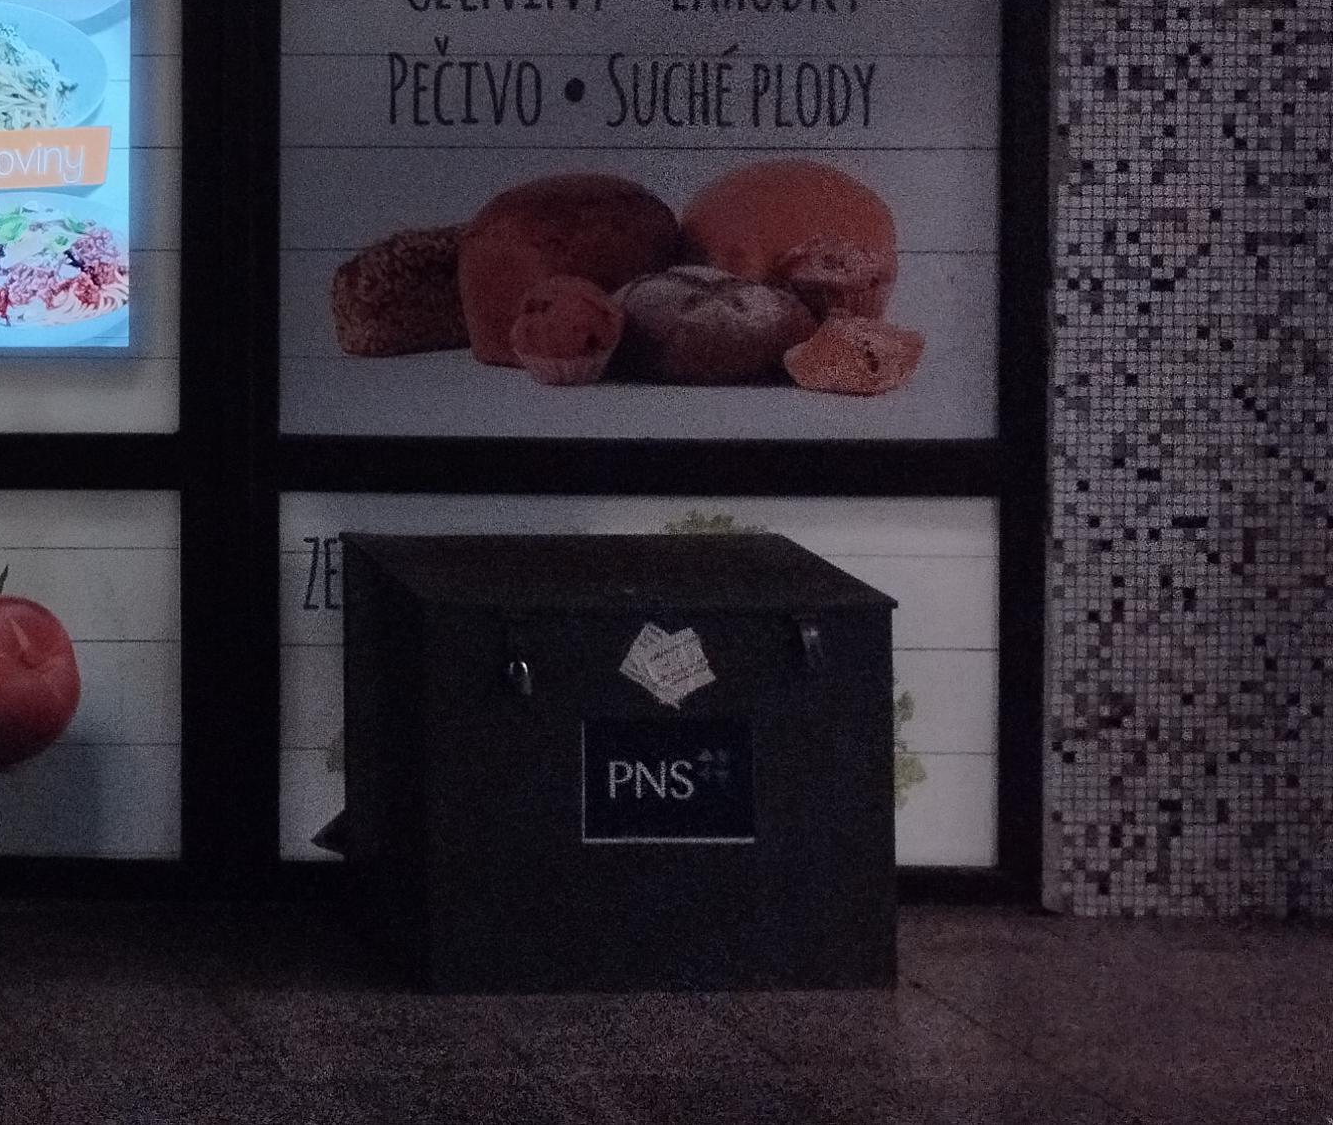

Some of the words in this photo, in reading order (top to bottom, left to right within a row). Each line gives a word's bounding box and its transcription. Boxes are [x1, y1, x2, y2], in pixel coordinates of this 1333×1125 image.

[387, 35, 542, 127] PEČIVO
[605, 43, 739, 128] SUCHÉ
[750, 62, 875, 128] PLODY
[609, 759, 695, 800] PNS
